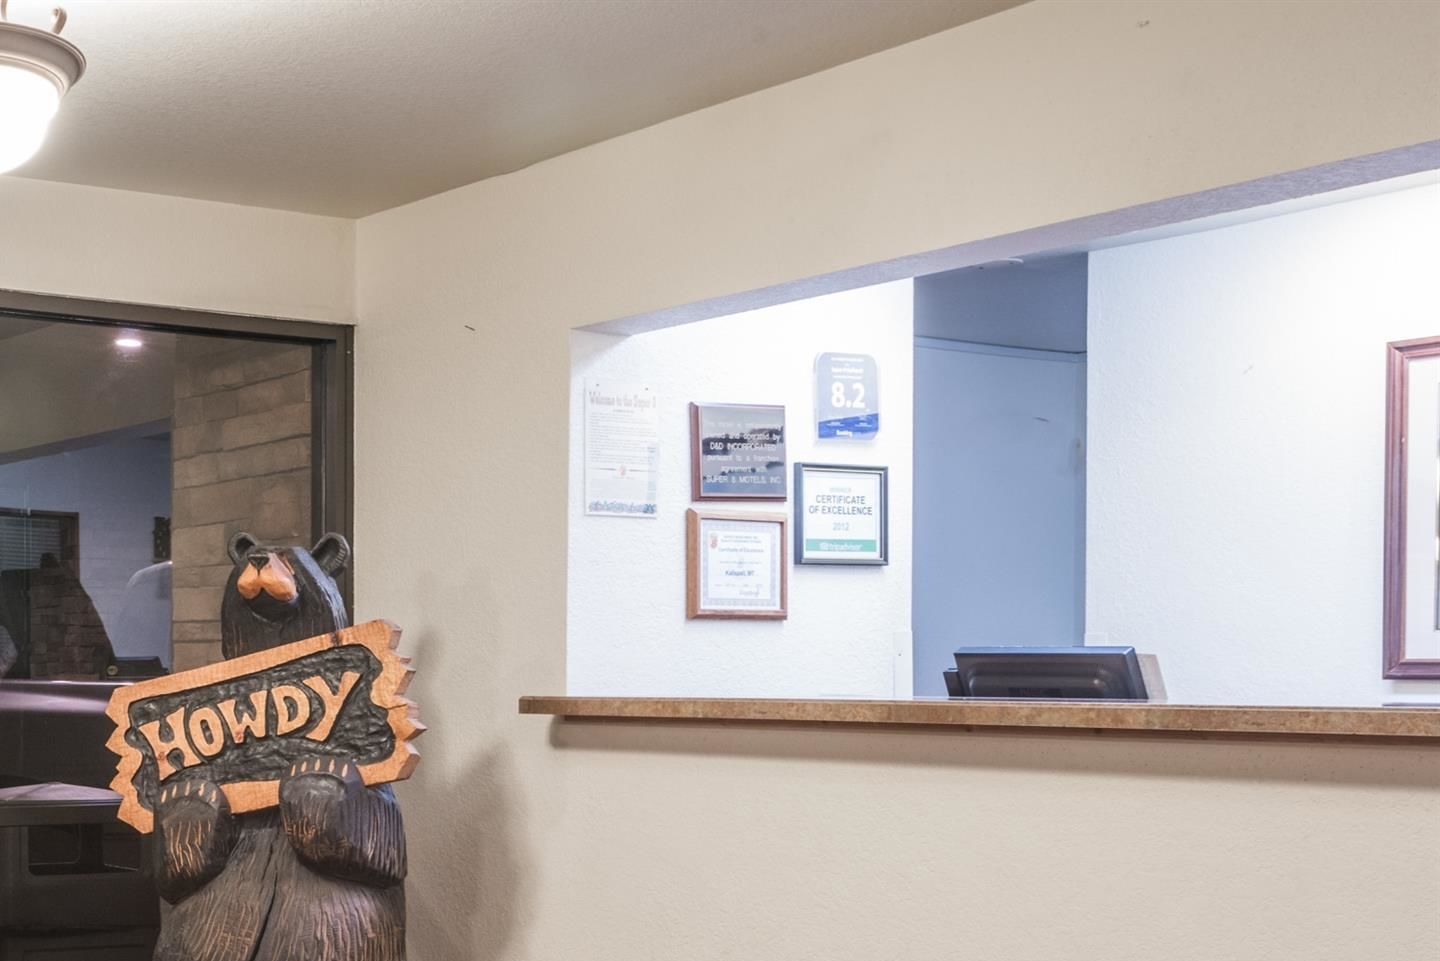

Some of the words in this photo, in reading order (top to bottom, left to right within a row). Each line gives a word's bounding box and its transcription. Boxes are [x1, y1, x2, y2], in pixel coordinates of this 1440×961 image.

[831, 381, 865, 408] 8.2
[815, 494, 866, 504] CERTIFICATE
[808, 505, 820, 514] OF
[821, 506, 873, 516] EXCELLENCE
[139, 671, 361, 782] HOWDY
